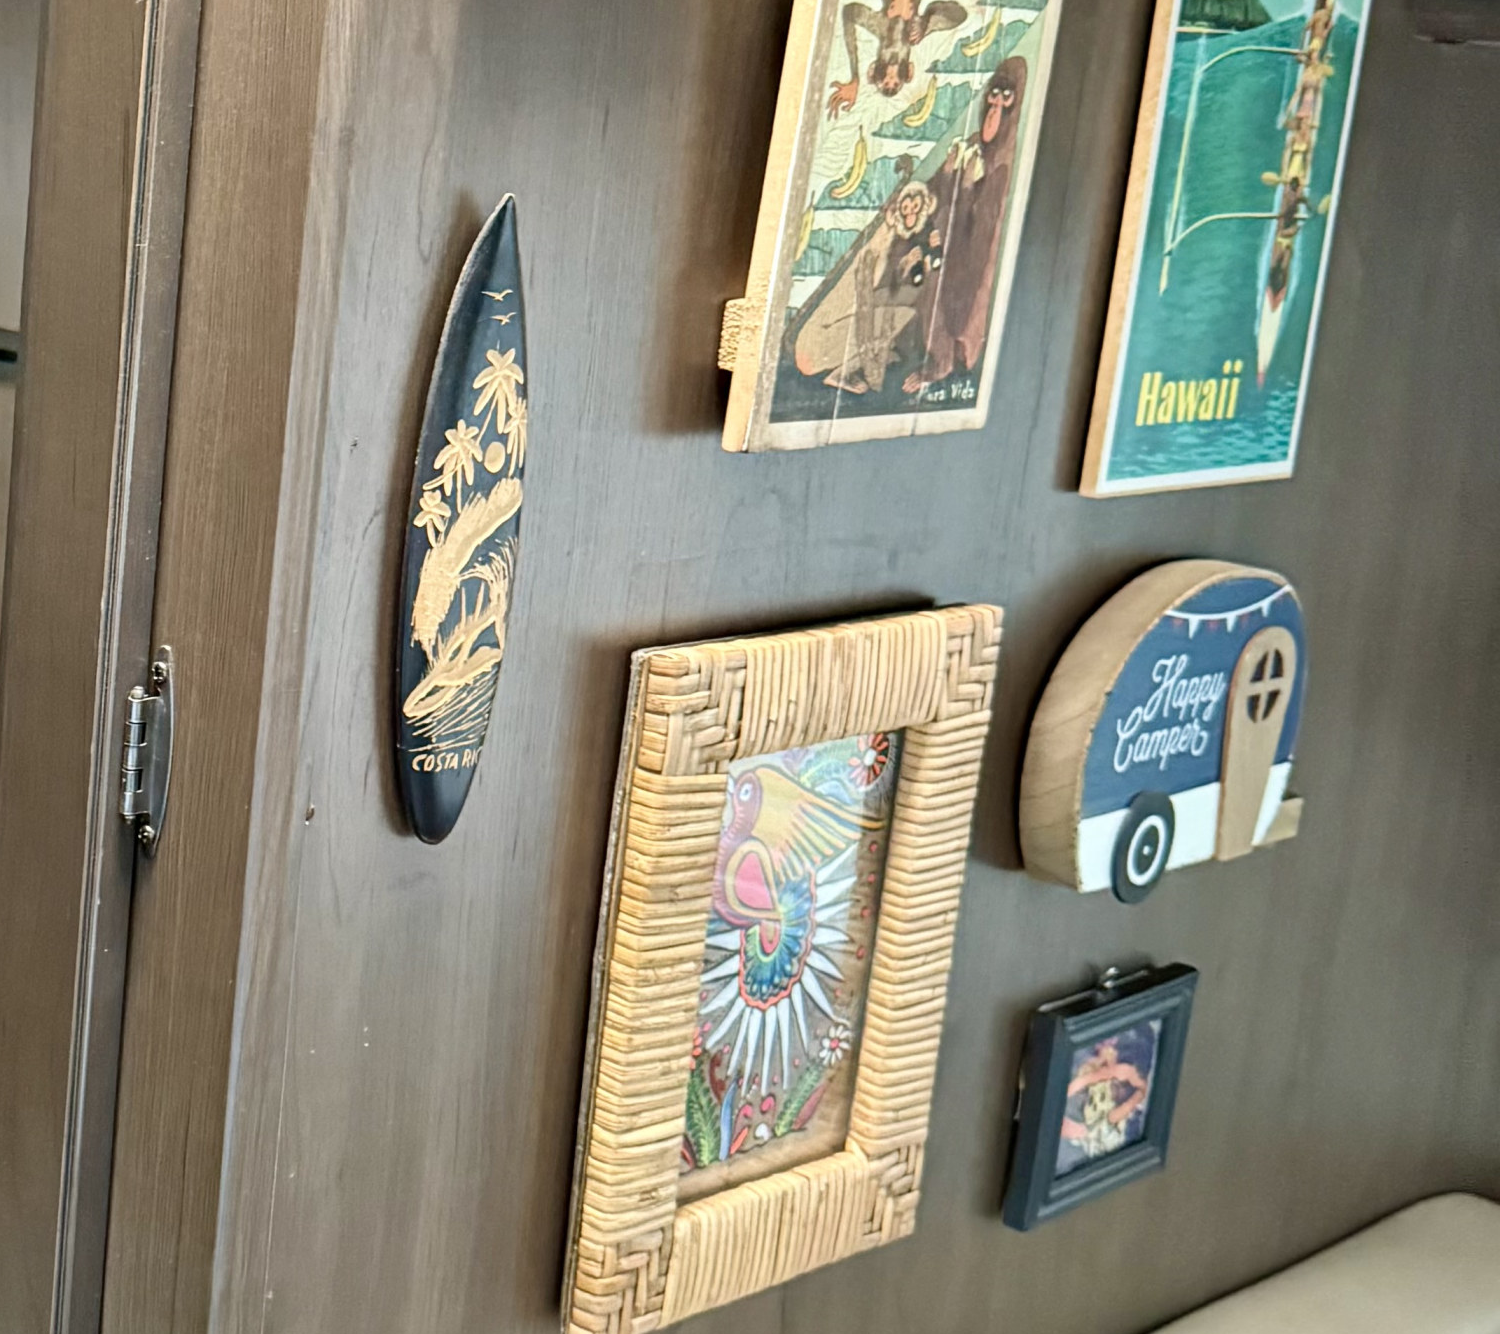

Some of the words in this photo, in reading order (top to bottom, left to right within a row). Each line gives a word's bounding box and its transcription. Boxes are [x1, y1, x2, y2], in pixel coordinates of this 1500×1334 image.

[1135, 359, 1243, 426] Hawaii
[1143, 654, 1226, 722] Happy
[412, 752, 459, 772] COSTA
[462, 746, 483, 768] RIC
[1114, 706, 1208, 773] Camper
